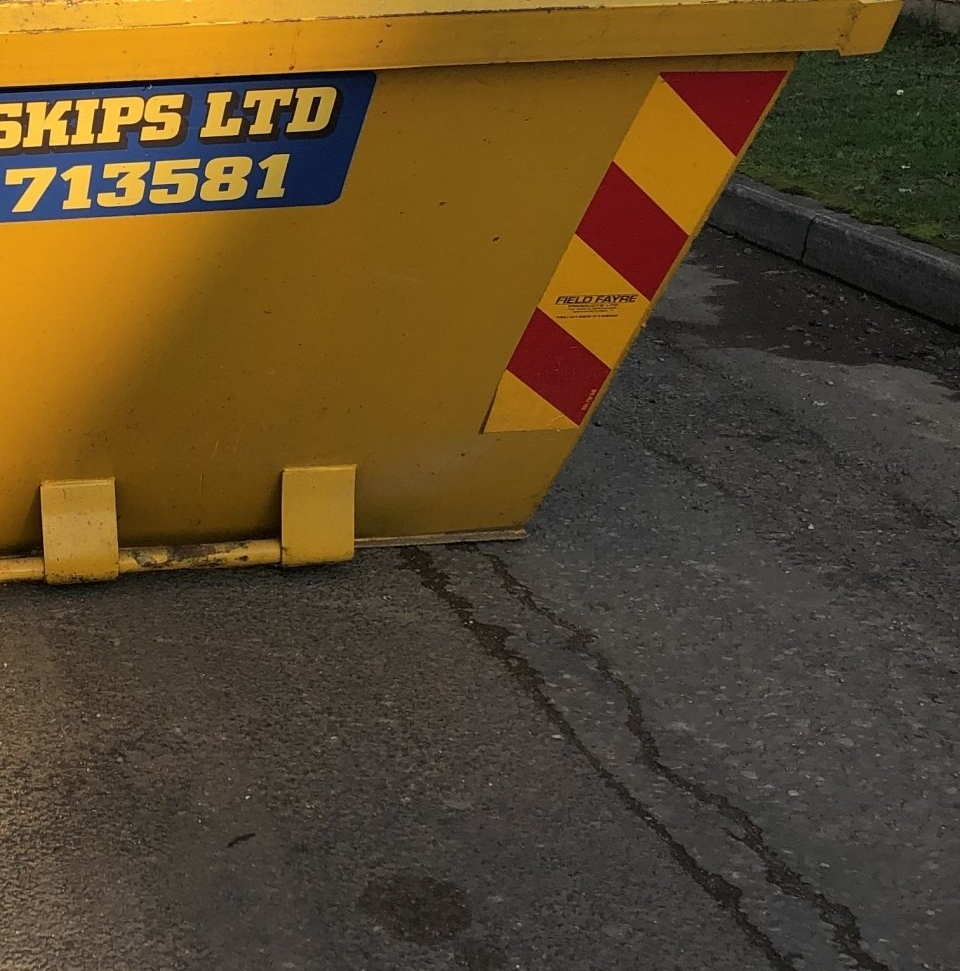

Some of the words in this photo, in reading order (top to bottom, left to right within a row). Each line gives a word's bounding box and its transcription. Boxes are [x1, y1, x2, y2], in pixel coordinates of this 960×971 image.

[198, 85, 343, 145] LTD
[3, 153, 292, 213] 713581
[555, 295, 594, 305] FIELD
[594, 293, 639, 304] FAYRE
